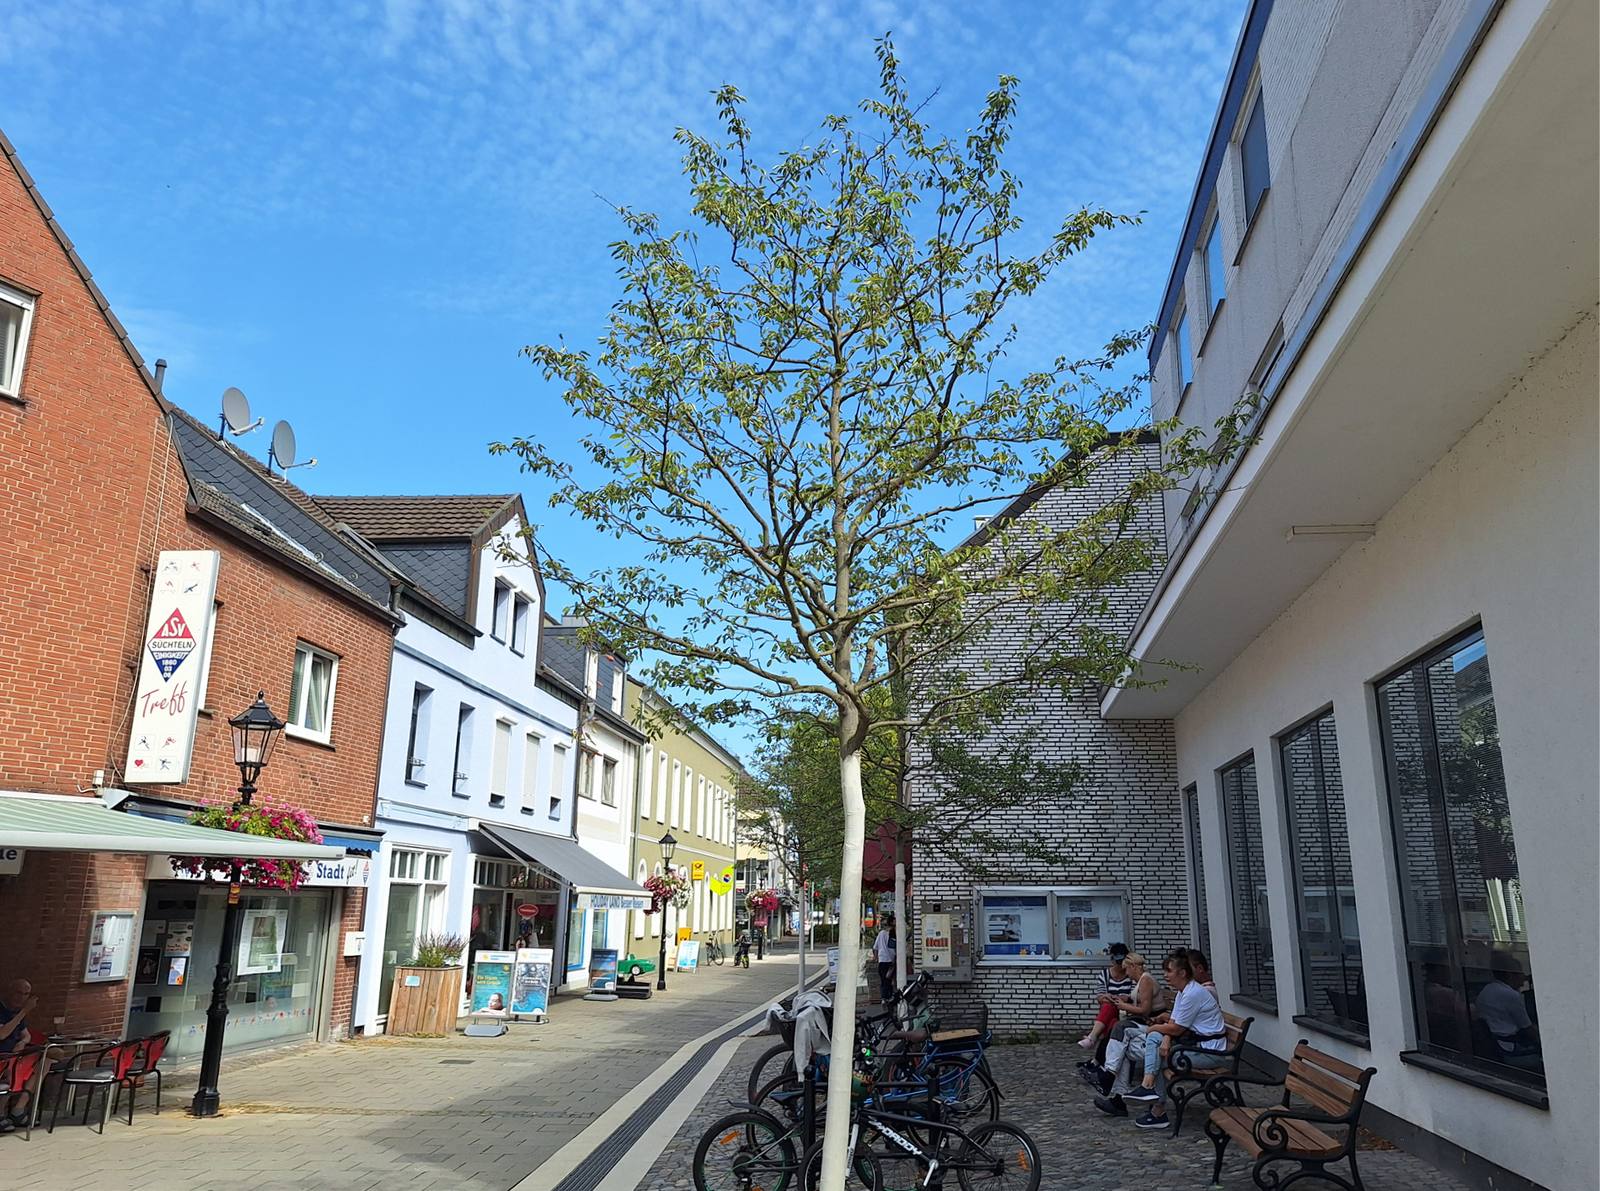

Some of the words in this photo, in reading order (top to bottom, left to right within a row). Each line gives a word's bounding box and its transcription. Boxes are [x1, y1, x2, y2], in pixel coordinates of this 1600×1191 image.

[161, 617, 187, 637] ASV
[152, 641, 193, 649] SÜCHTELN
[141, 681, 188, 718] Treff
[316, 863, 345, 880] Stadt
